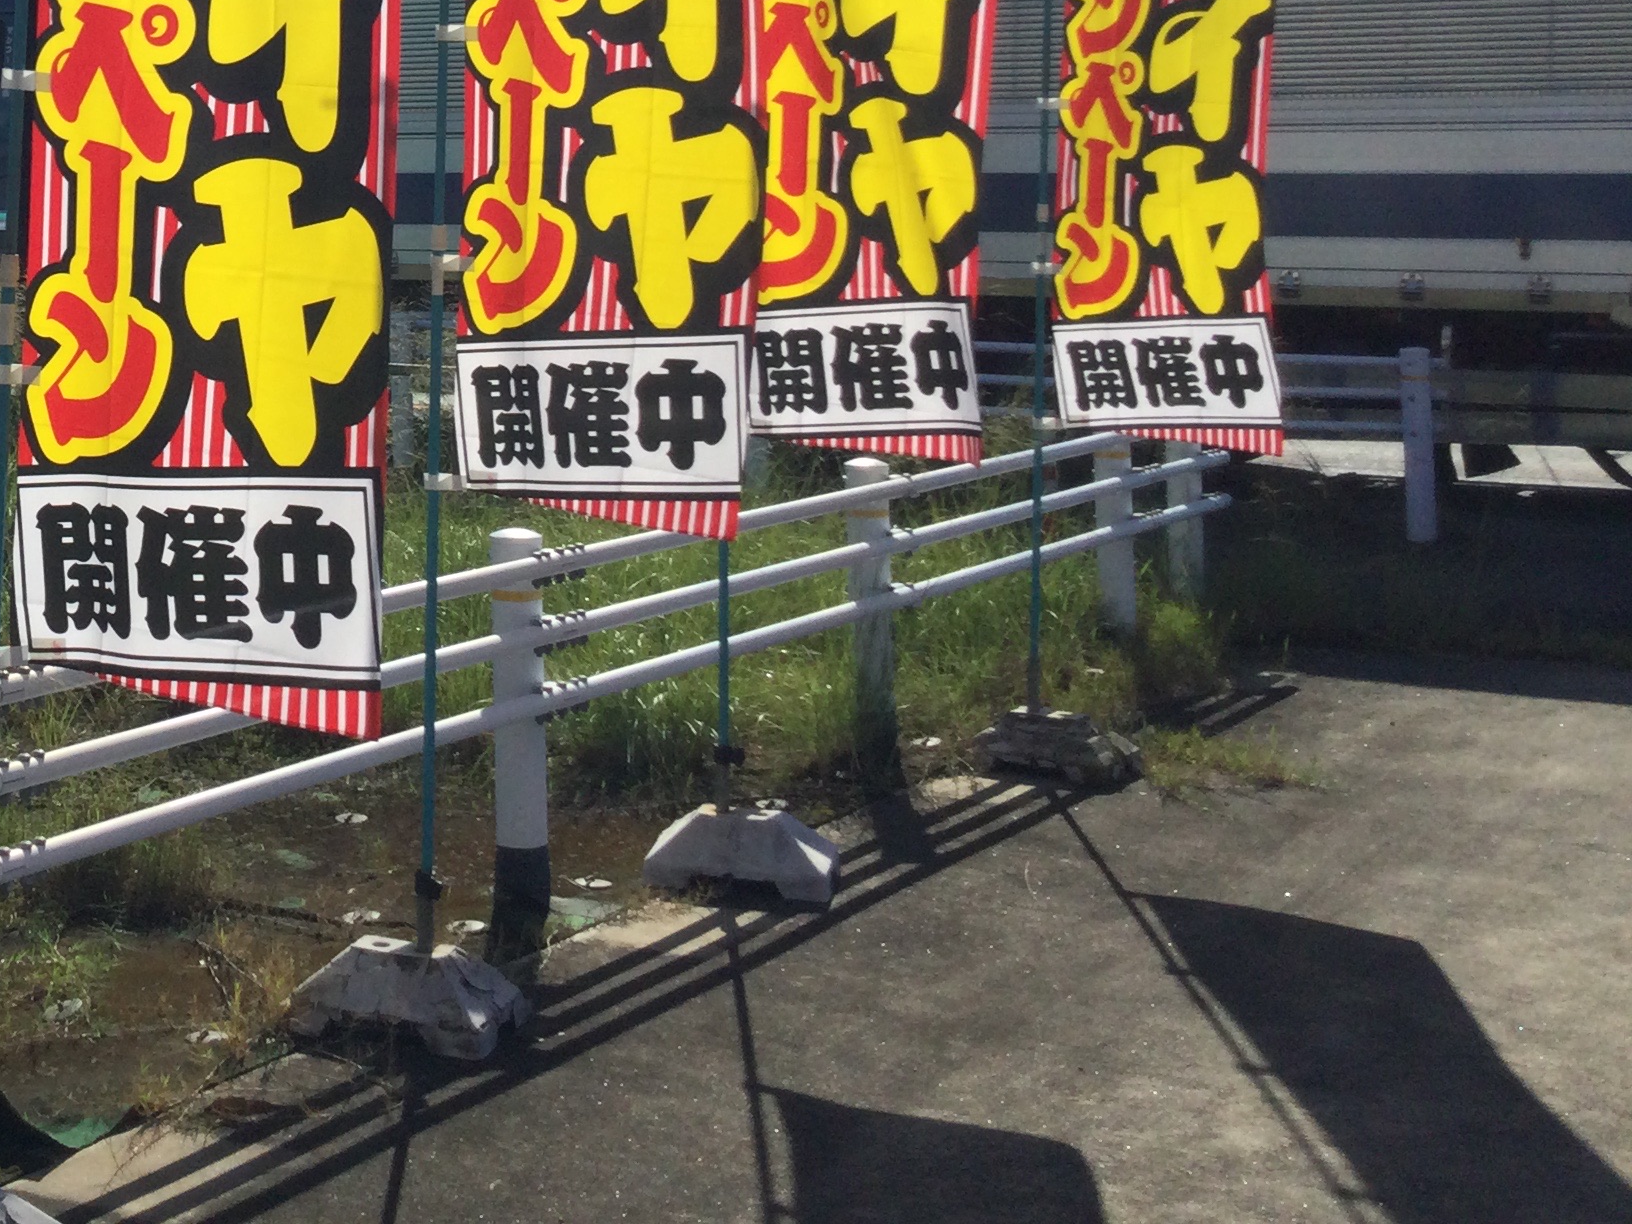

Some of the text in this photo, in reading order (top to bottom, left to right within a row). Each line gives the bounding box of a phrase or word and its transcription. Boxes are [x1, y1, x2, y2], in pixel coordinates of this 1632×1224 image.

[473, 359, 727, 471] 開催中
[755, 320, 967, 413] 開催中
[1068, 334, 1264, 410] 開催中
[33, 502, 359, 652] 開催中
